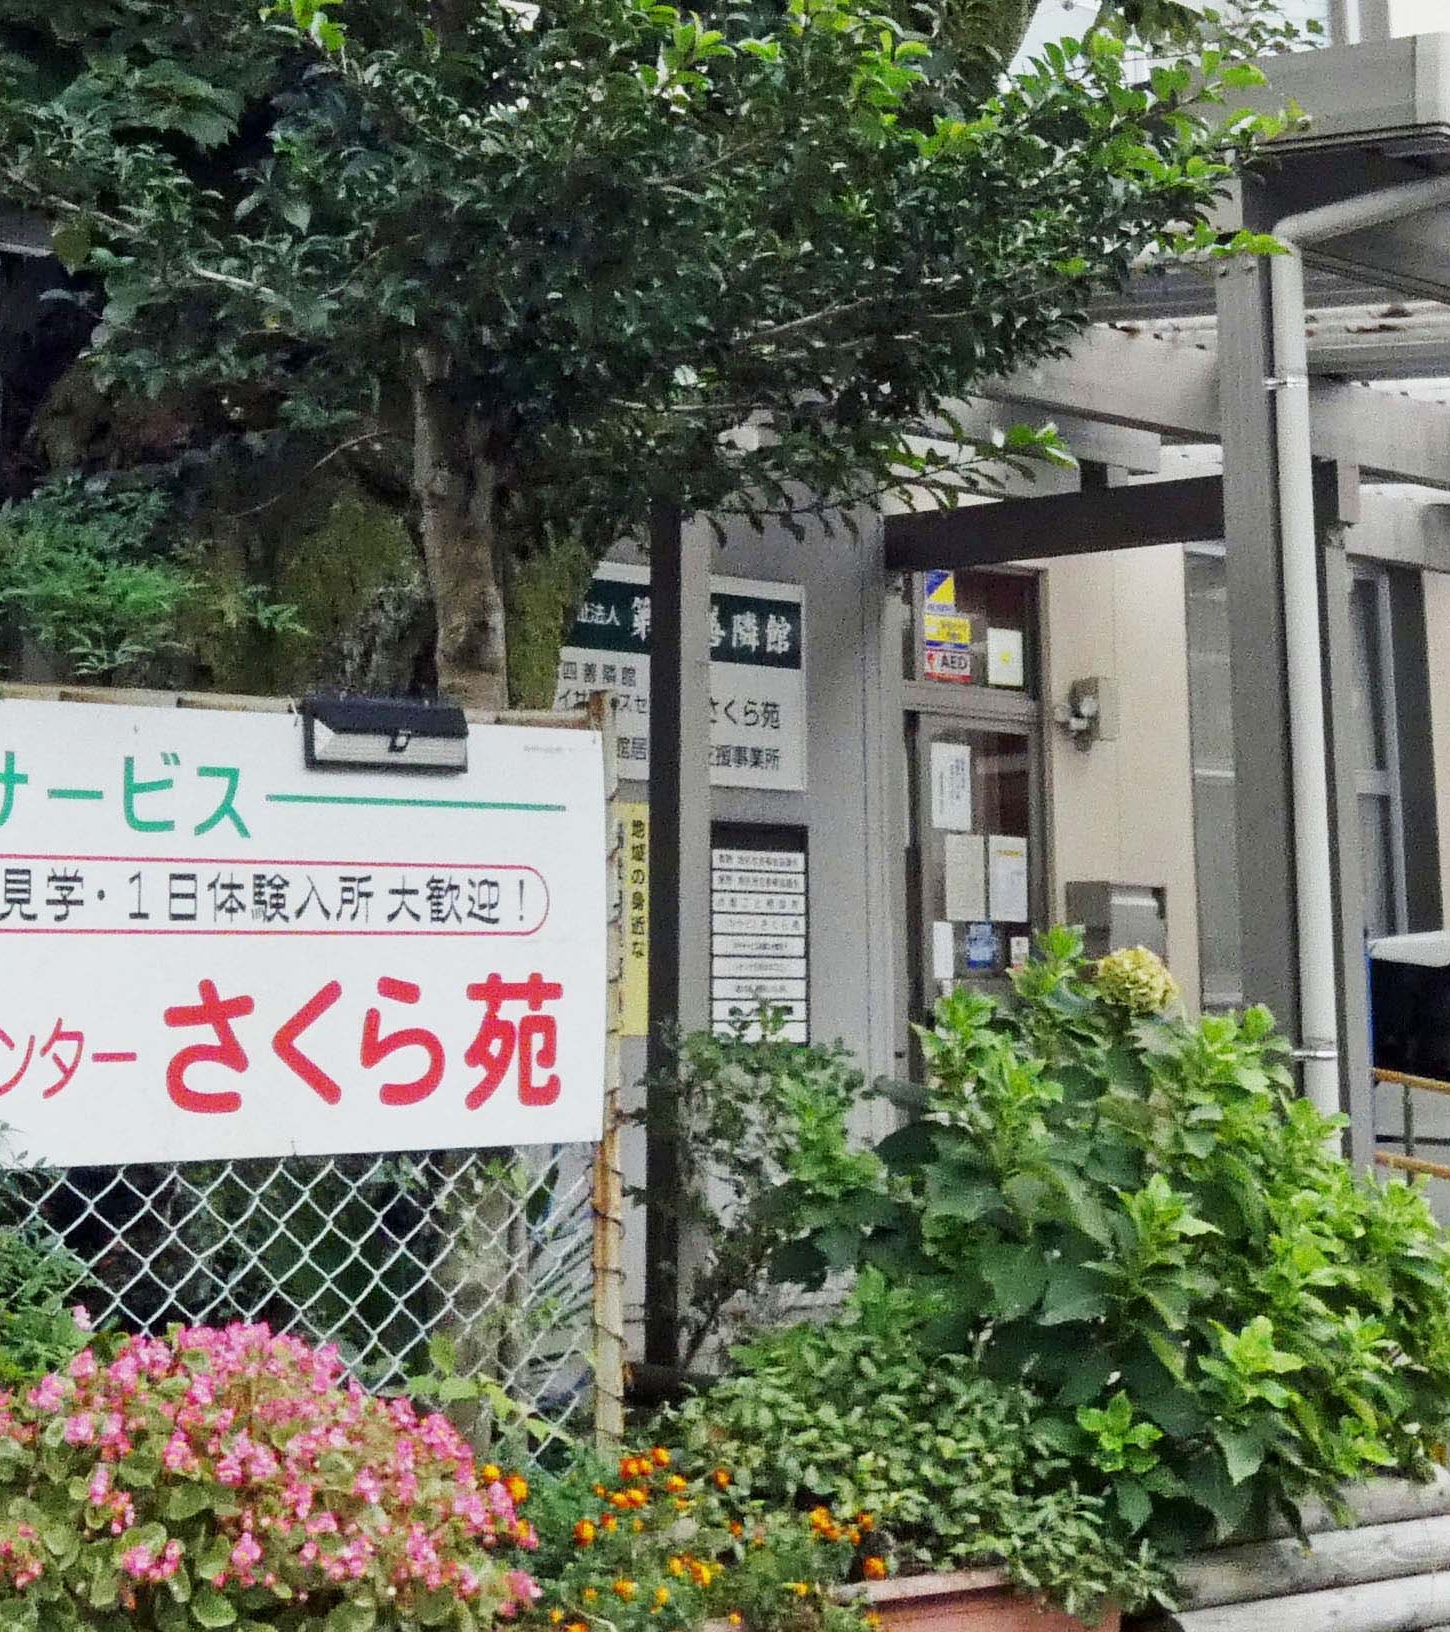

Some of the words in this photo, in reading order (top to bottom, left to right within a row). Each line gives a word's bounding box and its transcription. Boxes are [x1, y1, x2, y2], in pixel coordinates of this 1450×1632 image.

[941, 655, 968, 669] AED
[164, 972, 563, 1113] さくら苑
